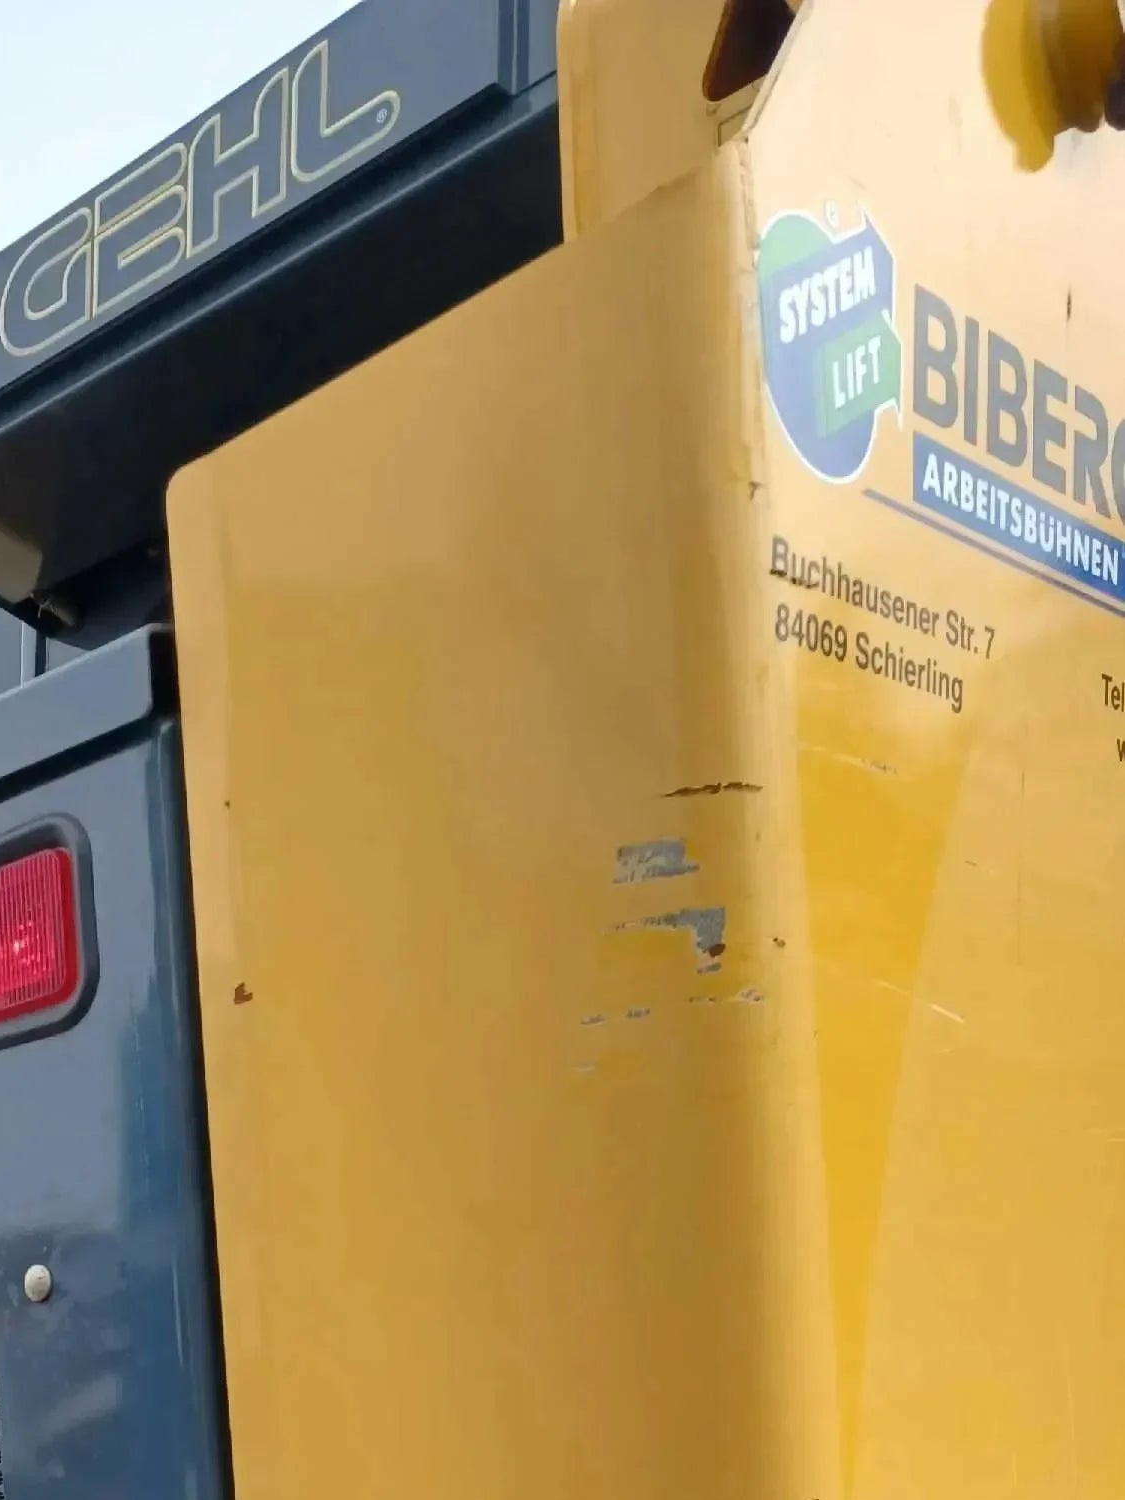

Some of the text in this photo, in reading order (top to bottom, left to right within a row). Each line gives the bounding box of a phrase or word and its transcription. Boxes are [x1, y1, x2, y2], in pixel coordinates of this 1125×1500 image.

[0, 39, 401, 356] GEHL
[779, 245, 876, 344] SYSTEM
[832, 335, 881, 409] LIFT
[923, 454, 1118, 585] ARBEITSBÜHNEN
[770, 535, 940, 637] Buchhausener
[775, 603, 964, 714] 84069 Schierling
